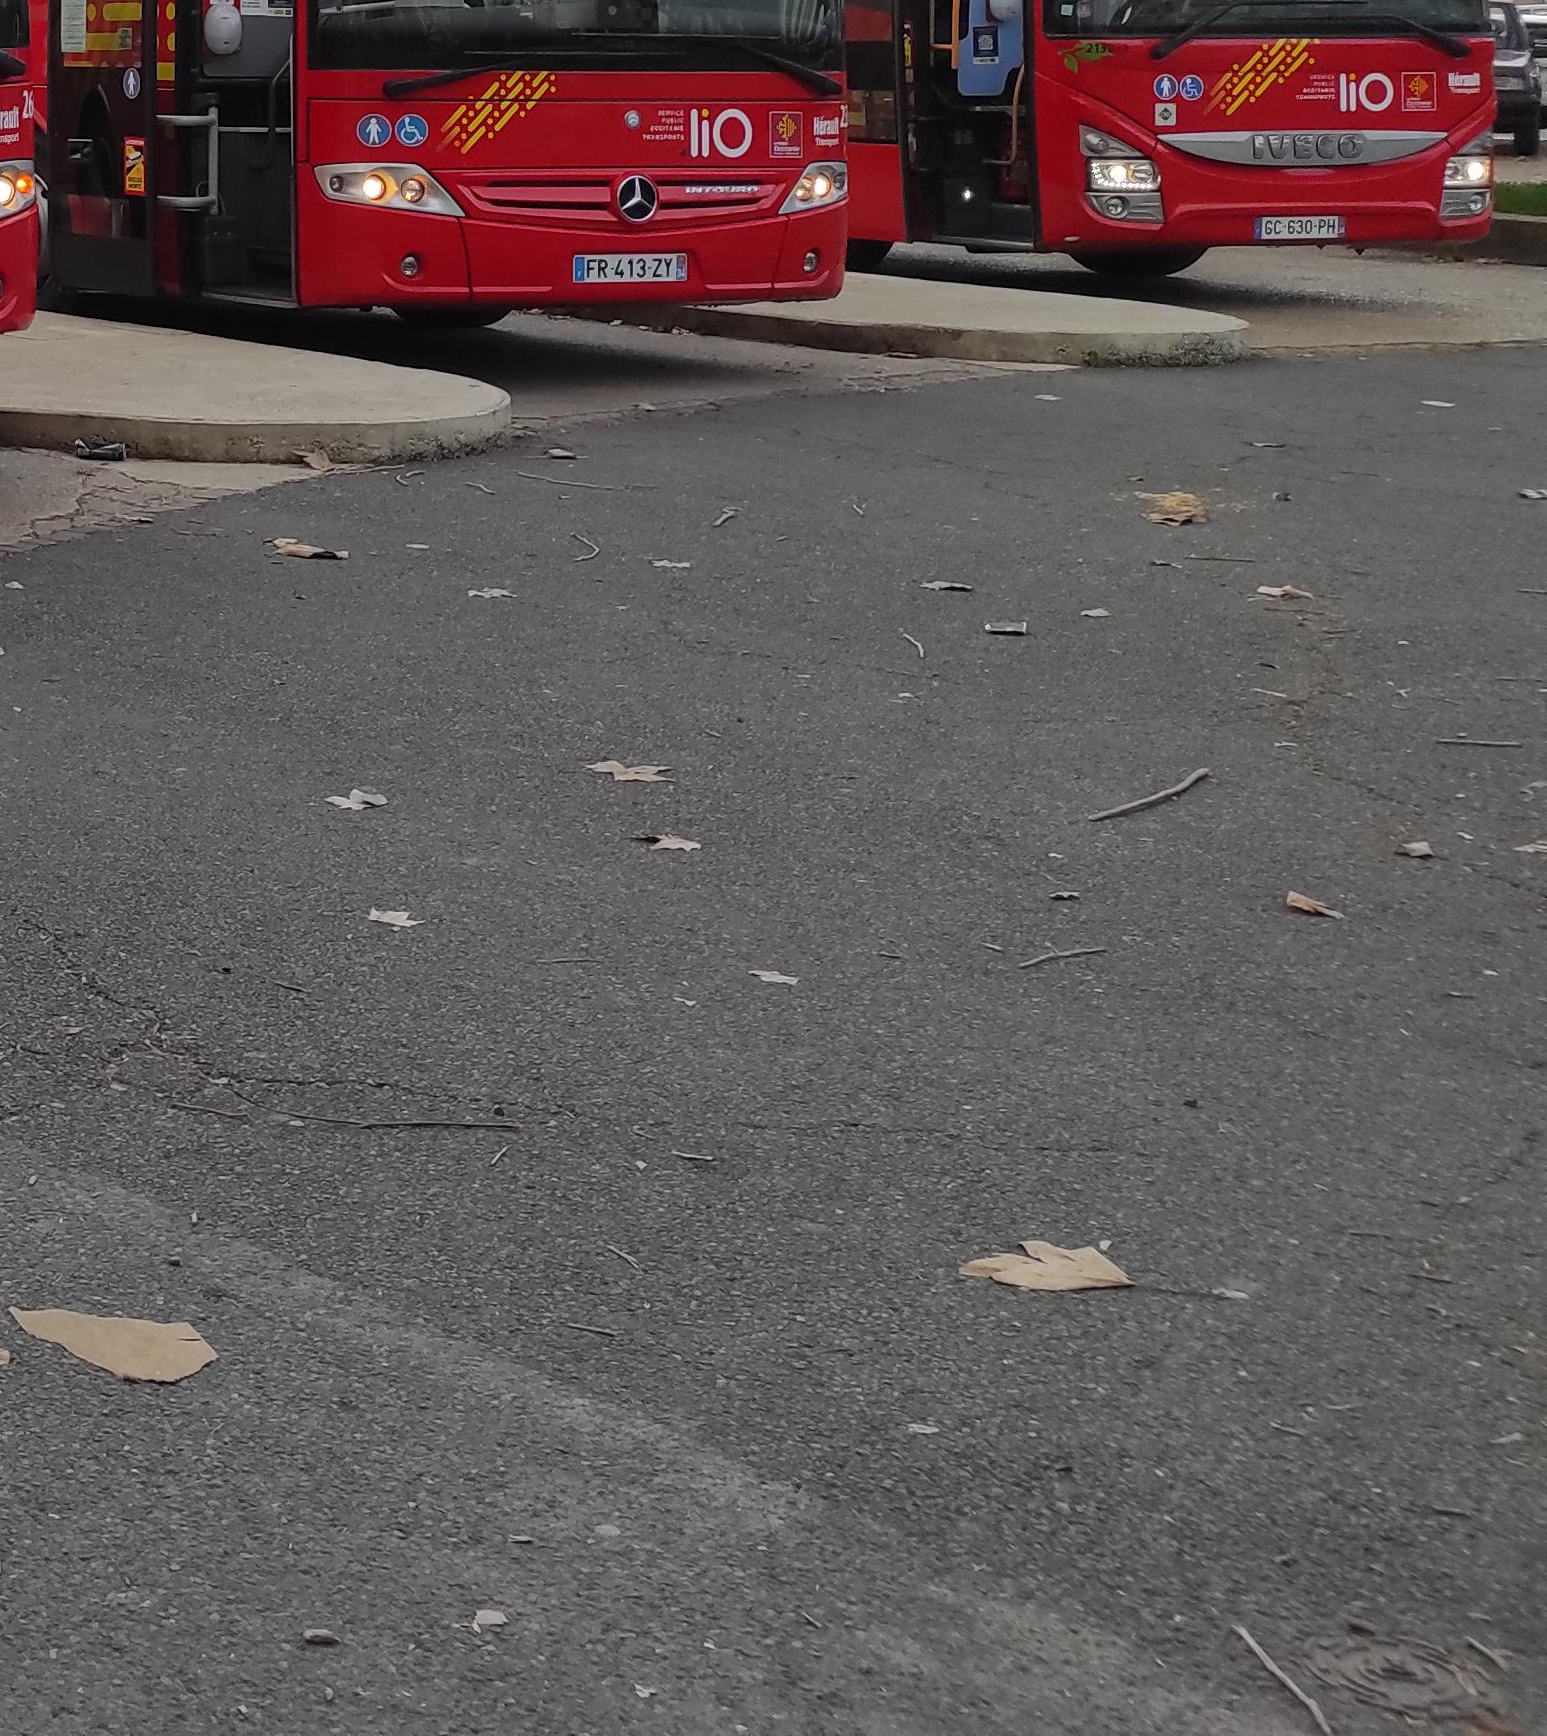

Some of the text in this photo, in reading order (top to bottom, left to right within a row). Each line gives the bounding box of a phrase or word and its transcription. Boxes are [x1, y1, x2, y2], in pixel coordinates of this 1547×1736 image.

[1251, 134, 1365, 159] IVECO
[1264, 219, 1336, 235] GC-630-PH
[587, 258, 673, 278] FR-413-ZY
